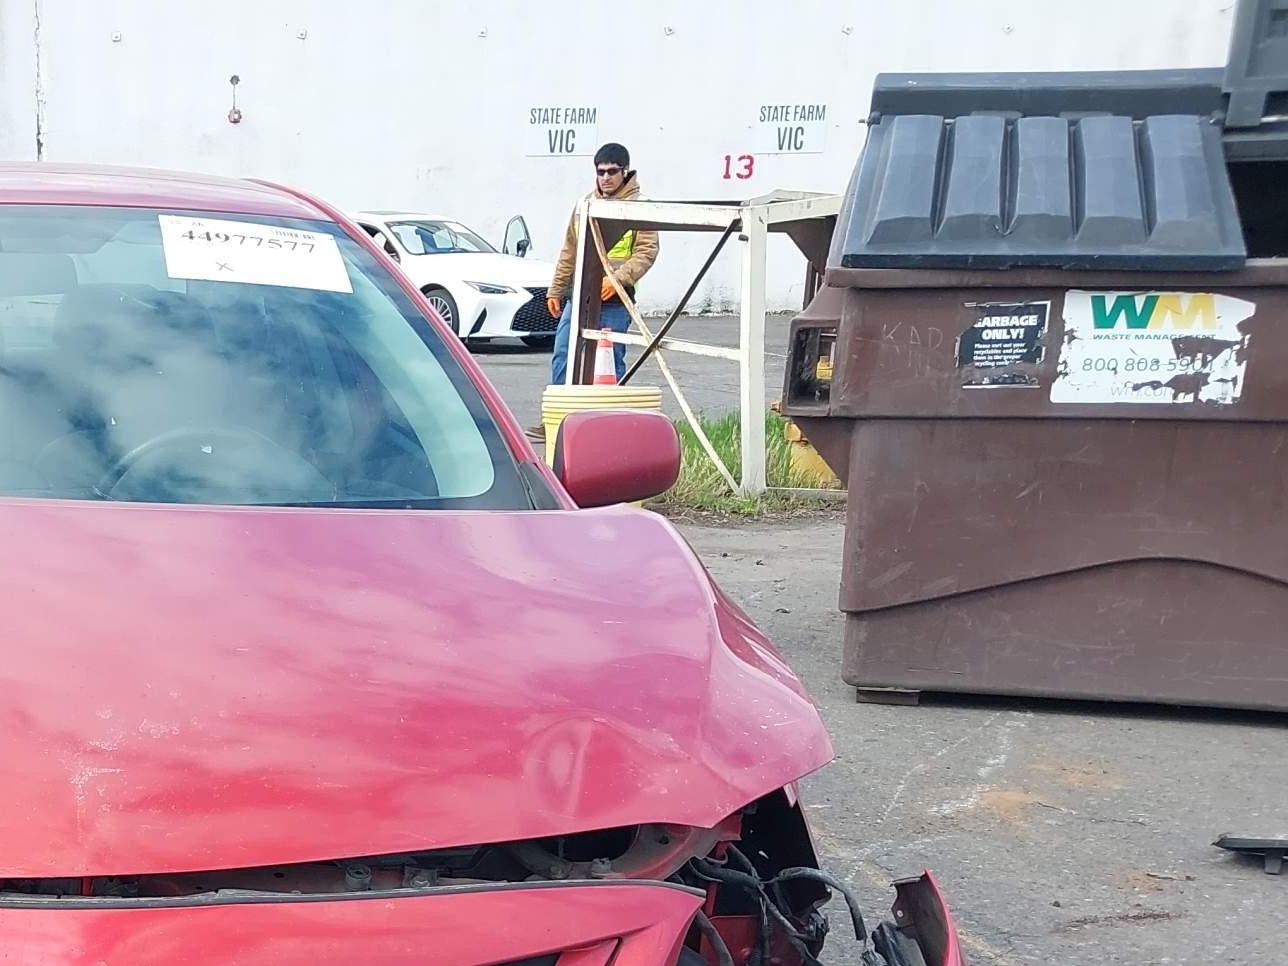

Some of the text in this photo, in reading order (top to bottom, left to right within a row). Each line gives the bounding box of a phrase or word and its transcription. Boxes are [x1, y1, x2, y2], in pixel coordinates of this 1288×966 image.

[529, 107, 597, 125] STATE FARM
[759, 104, 827, 122] STATE FARM
[548, 129, 576, 154] VIC
[777, 126, 805, 151] VIC
[722, 154, 755, 180] 13
[180, 228, 316, 254] 44977577
[1090, 293, 1217, 330] WM
[981, 328, 1025, 340] ONLY!
[1092, 333, 1131, 341] WASTE
[1082, 357, 1119, 372] 800
[1124, 357, 1160, 372] 808
